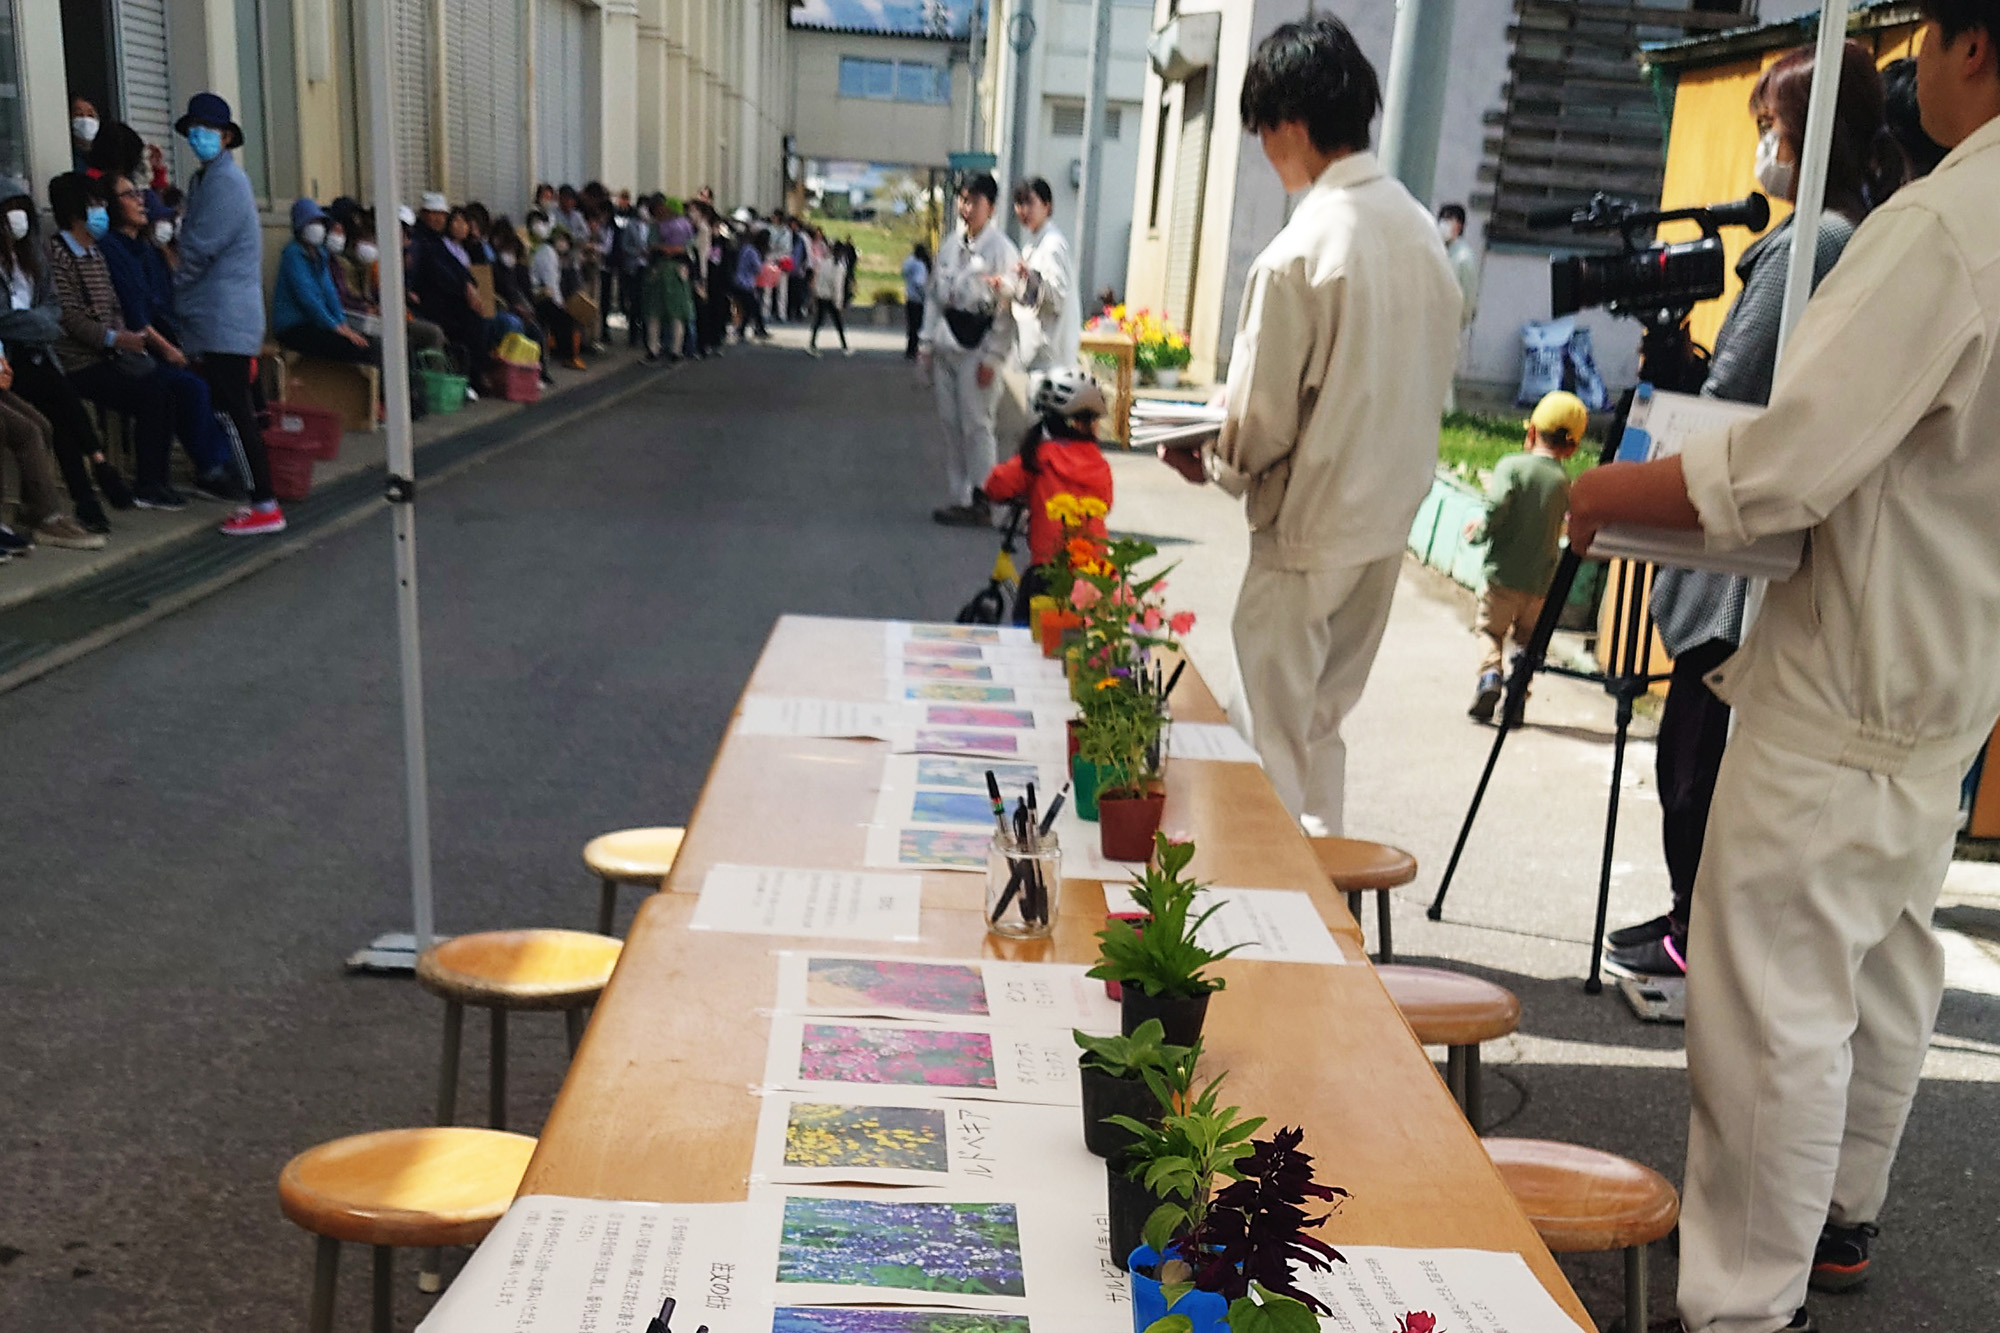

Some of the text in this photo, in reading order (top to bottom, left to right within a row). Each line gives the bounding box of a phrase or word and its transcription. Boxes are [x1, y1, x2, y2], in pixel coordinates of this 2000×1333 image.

[957, 1109, 995, 1179] ルドベキア
[705, 1262, 735, 1311] 注文の仕方
